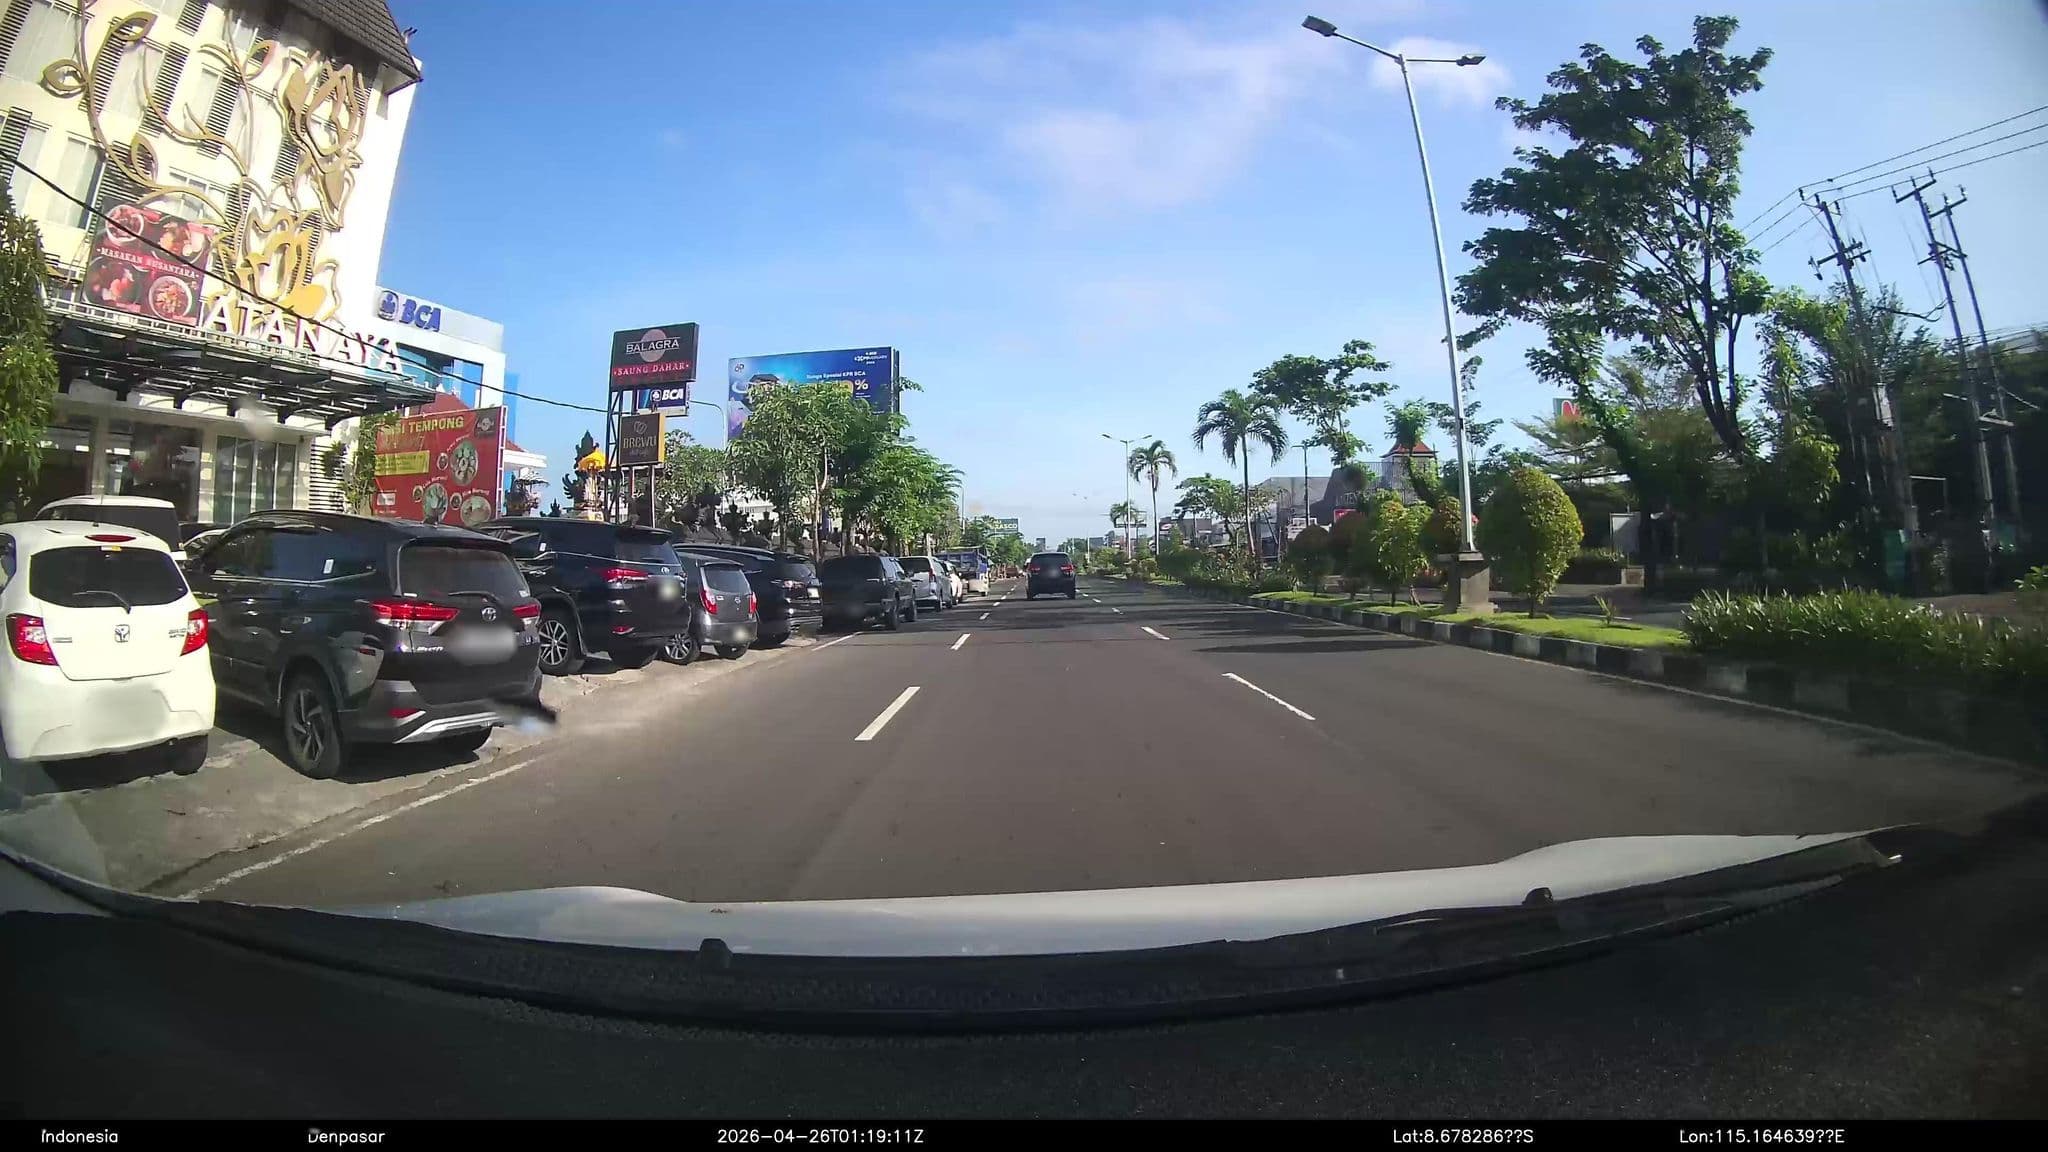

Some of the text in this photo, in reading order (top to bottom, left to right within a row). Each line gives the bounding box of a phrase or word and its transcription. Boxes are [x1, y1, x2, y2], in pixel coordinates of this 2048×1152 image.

[101, 247, 196, 279] MASAKAN NUSANTARA
[398, 298, 441, 332] BCA
[203, 295, 405, 374] ATANAYA
[626, 338, 680, 354] BALAGRA
[617, 362, 685, 376] SAUNG DAHAR
[661, 388, 684, 400] BCA
[408, 416, 465, 433] TEMPONG
